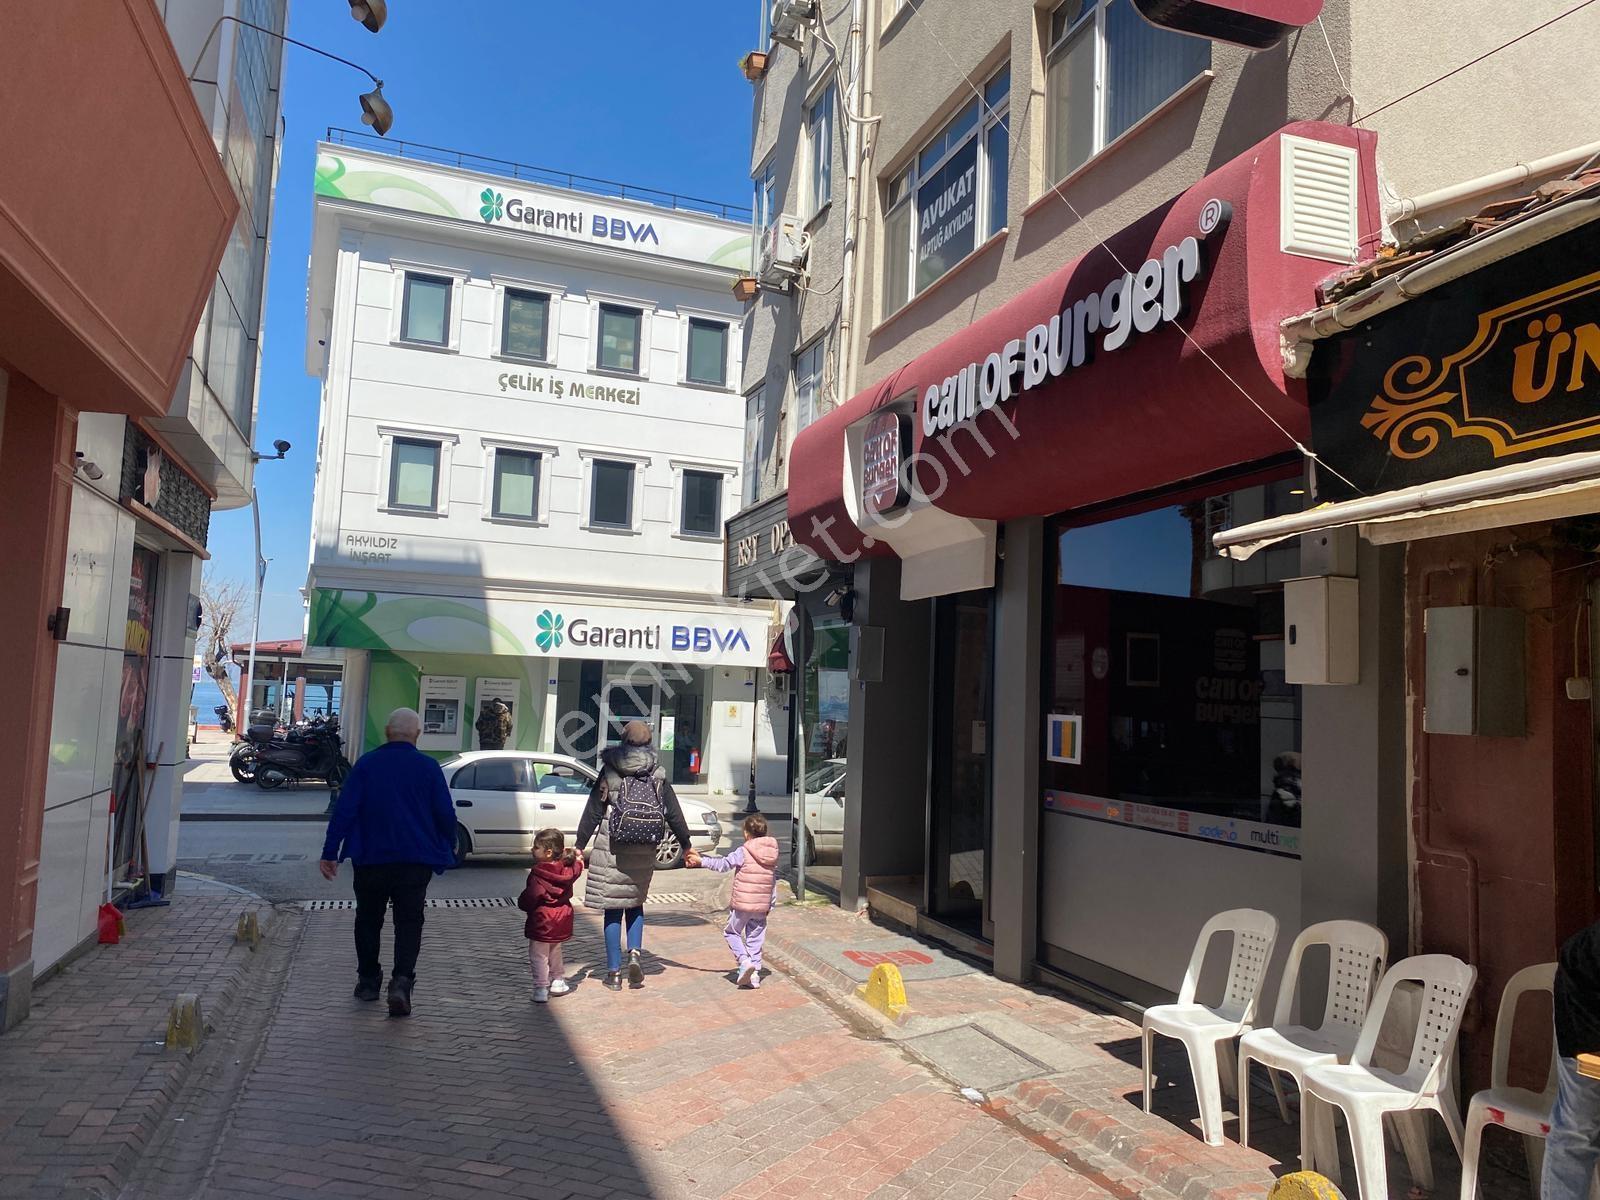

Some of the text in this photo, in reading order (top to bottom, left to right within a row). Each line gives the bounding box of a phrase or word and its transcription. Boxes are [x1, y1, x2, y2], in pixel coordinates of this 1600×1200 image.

[921, 165, 975, 235] AVUKAT
[506, 198, 659, 246] Garanti BBVA
[919, 203, 974, 264] ALPTUĞ AKYILDIZ
[498, 372, 641, 406] ÇELİK İŞ MERKEZİ
[346, 534, 398, 549] AKYILDIZ
[350, 548, 392, 565] İNŞAAT
[567, 618, 751, 653] Garanti BBVA
